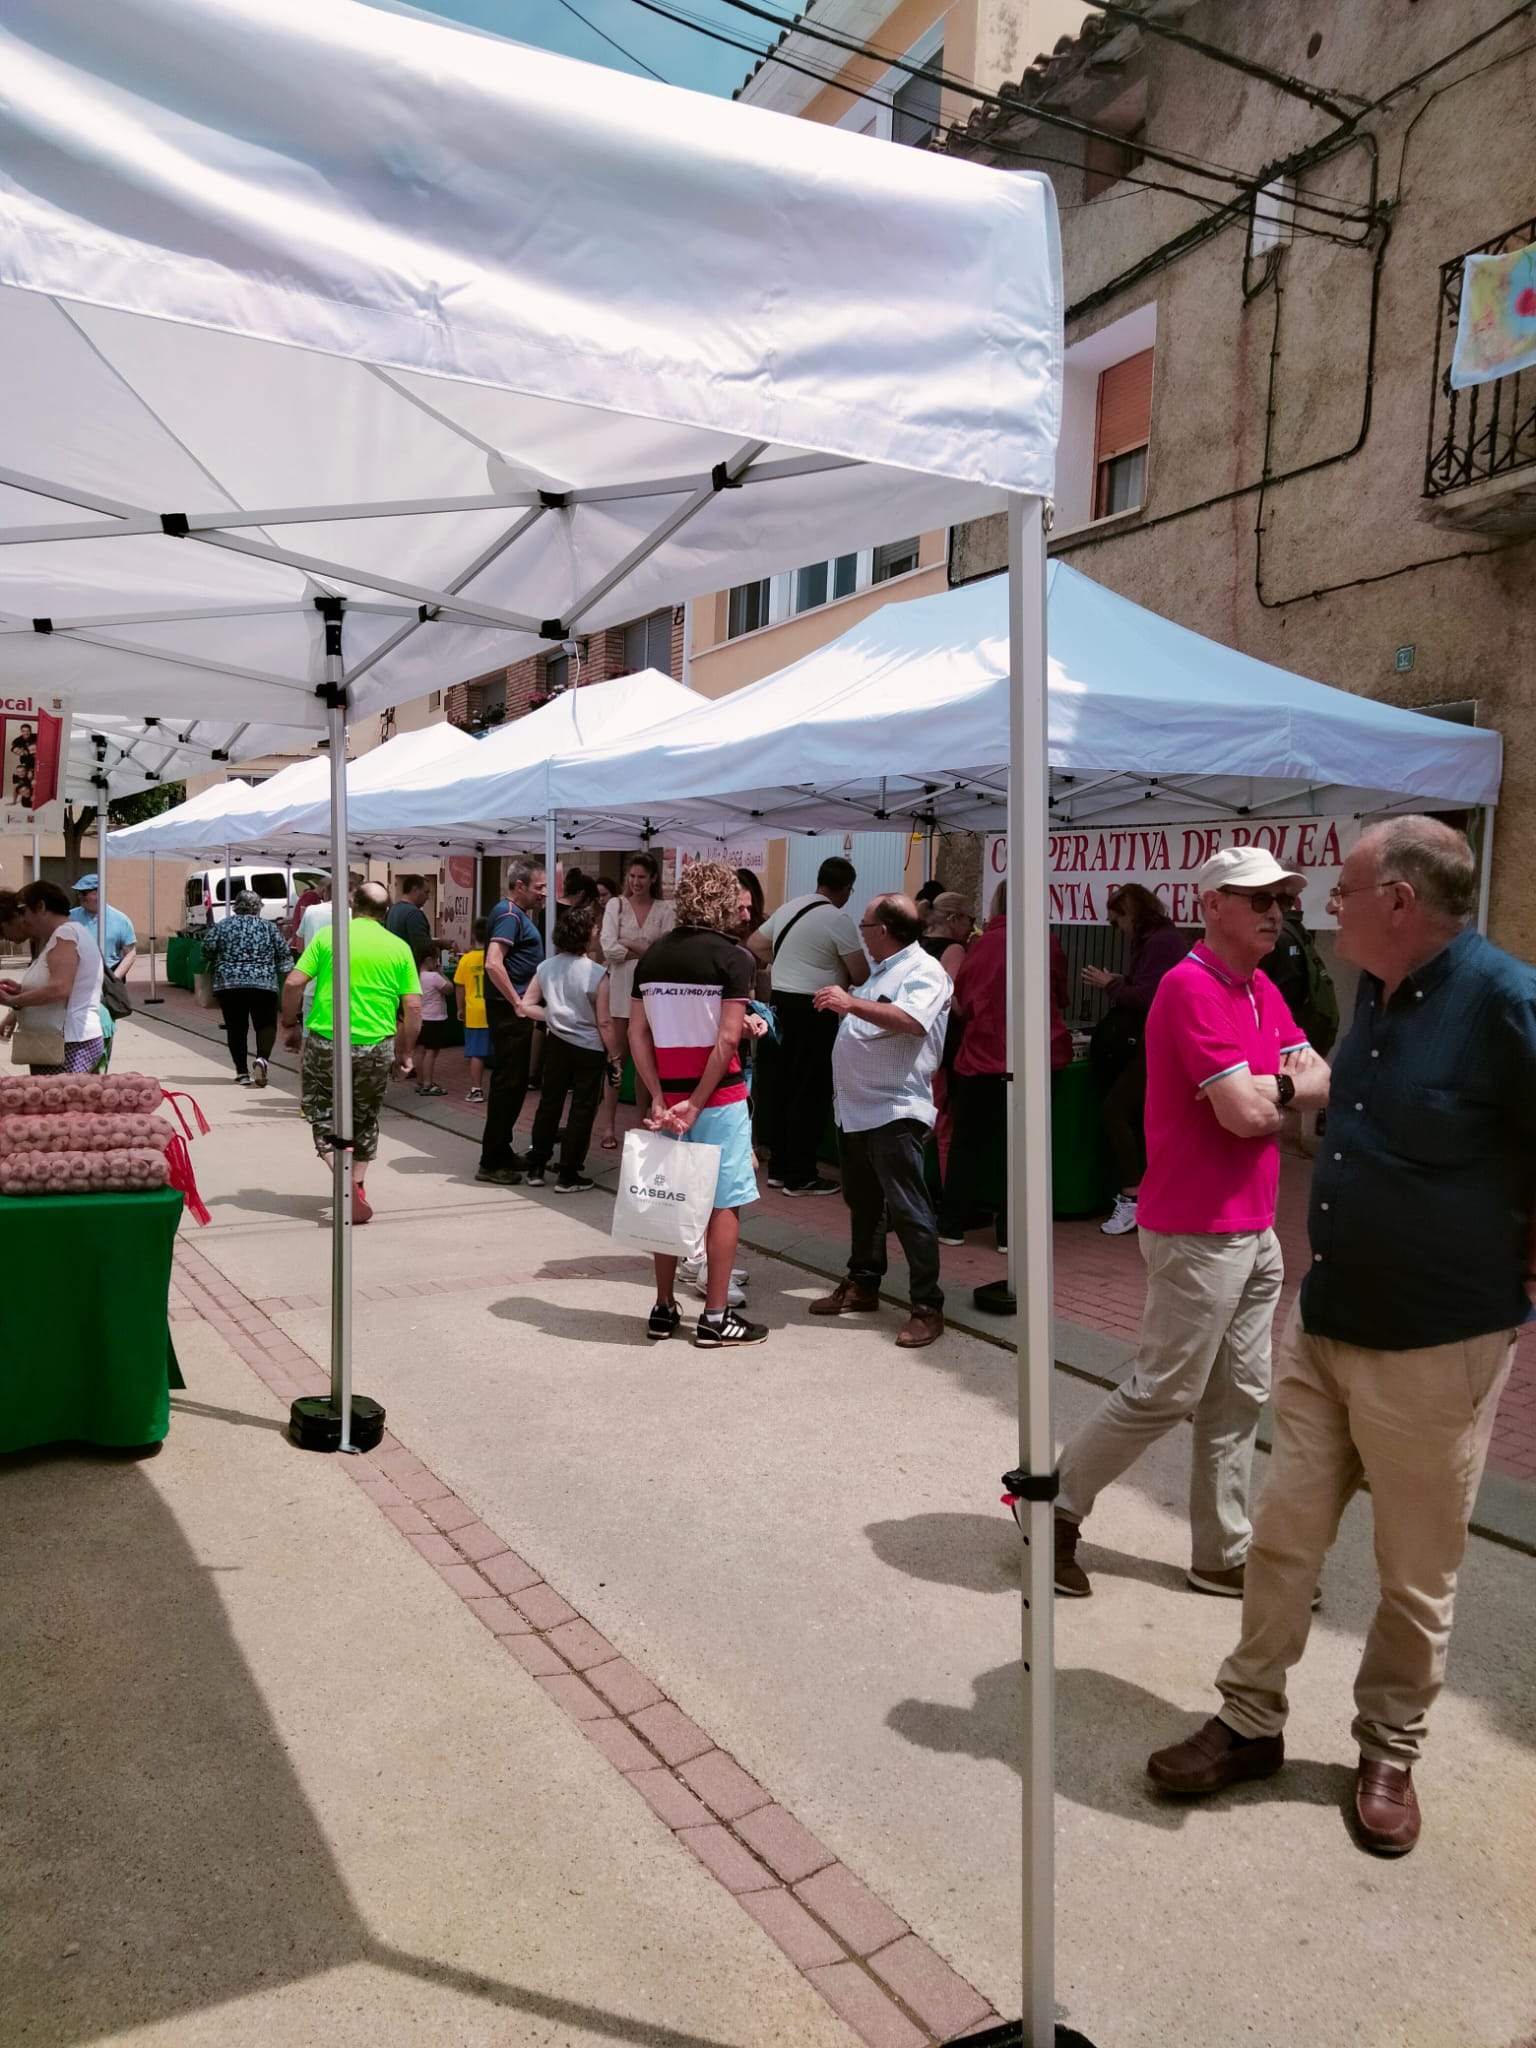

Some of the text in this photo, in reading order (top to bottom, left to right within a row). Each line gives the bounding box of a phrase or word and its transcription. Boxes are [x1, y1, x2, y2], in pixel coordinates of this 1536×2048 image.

[991, 831, 1171, 873] CERATIVA
[1048, 883, 1098, 921] NTA
[629, 1185, 686, 1202] CASBAS
